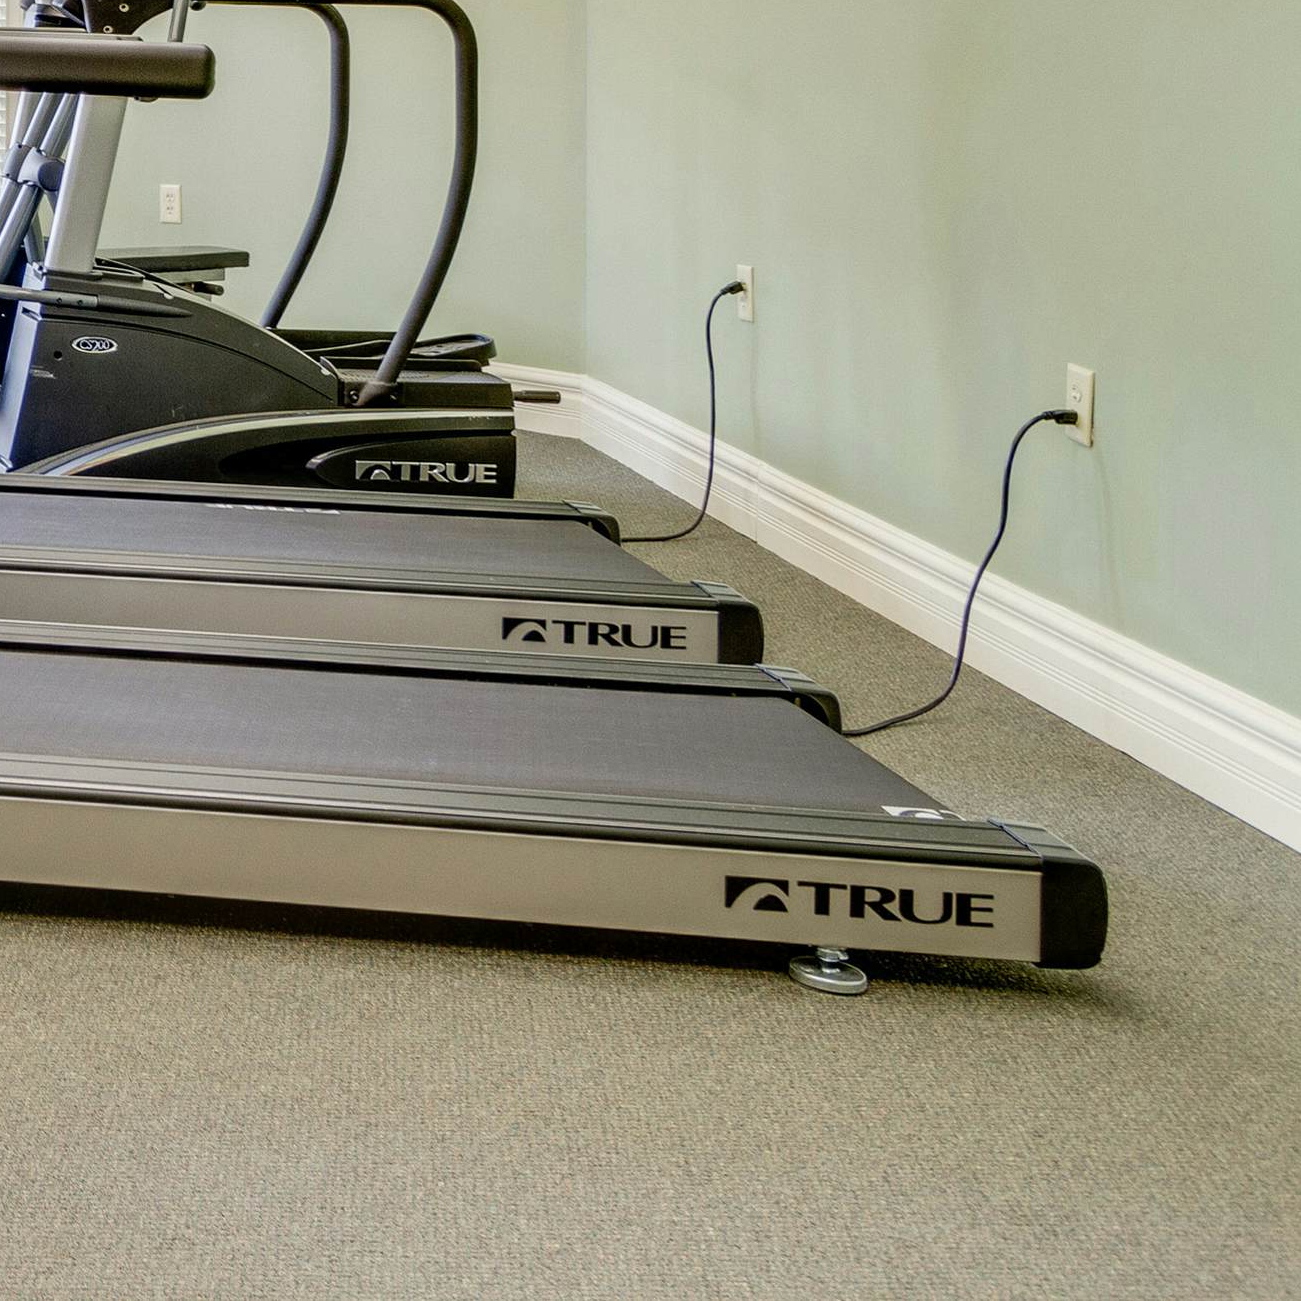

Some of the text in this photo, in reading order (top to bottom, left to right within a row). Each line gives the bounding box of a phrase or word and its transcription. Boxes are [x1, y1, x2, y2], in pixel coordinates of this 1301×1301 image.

[392, 460, 498, 484] TRUE
[551, 619, 687, 650] TRUE
[796, 880, 995, 929] TRUE
